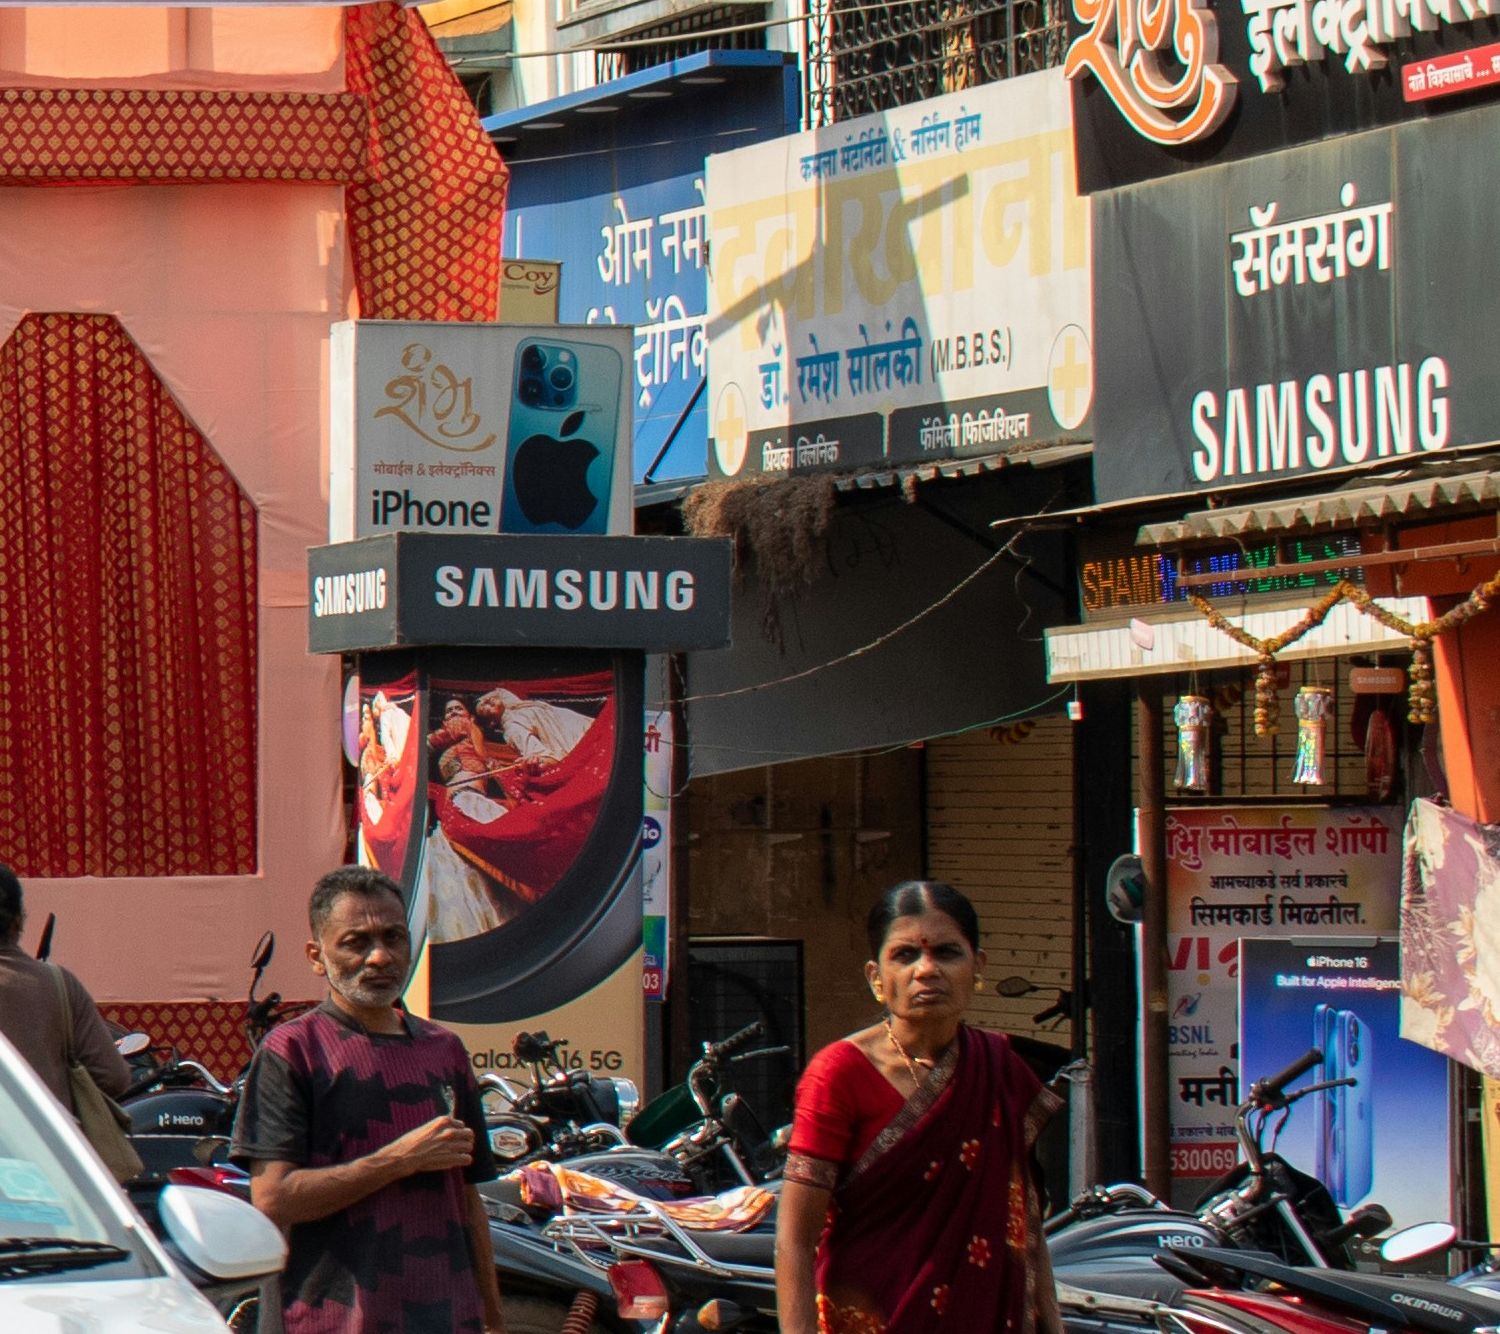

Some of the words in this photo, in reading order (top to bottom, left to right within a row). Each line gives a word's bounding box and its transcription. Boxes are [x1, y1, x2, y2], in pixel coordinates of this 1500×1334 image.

[892, 128, 907, 162] &
[596, 199, 652, 286] ओम
[796, 333, 839, 403] रमेश
[846, 317, 922, 397] सोलंकी
[929, 327, 1012, 383] (M.B.B.S.)
[1192, 356, 1450, 482] SAMSUNG
[416, 462, 425, 476] &
[372, 490, 490, 527] iPhone
[313, 568, 387, 619] SAMSUNG
[434, 566, 695, 611] SAMSUNG
[1190, 893, 1274, 926] सिमकार्ड
[1316, 956, 1353, 968] iPhone
[1355, 957, 1367, 968] 16
[1276, 975, 1301, 987] Built
[1302, 975, 1315, 987] for
[1317, 975, 1348, 990] Apple
[1349, 976, 1401, 990] Intelligenc
[1167, 1023, 1214, 1045] BSNL
[590, 1051, 622, 1070] 5G
[173, 1115, 204, 1125] Hero
[1159, 1235, 1204, 1249] Hero
[1390, 1293, 1464, 1322] OKINAWA
